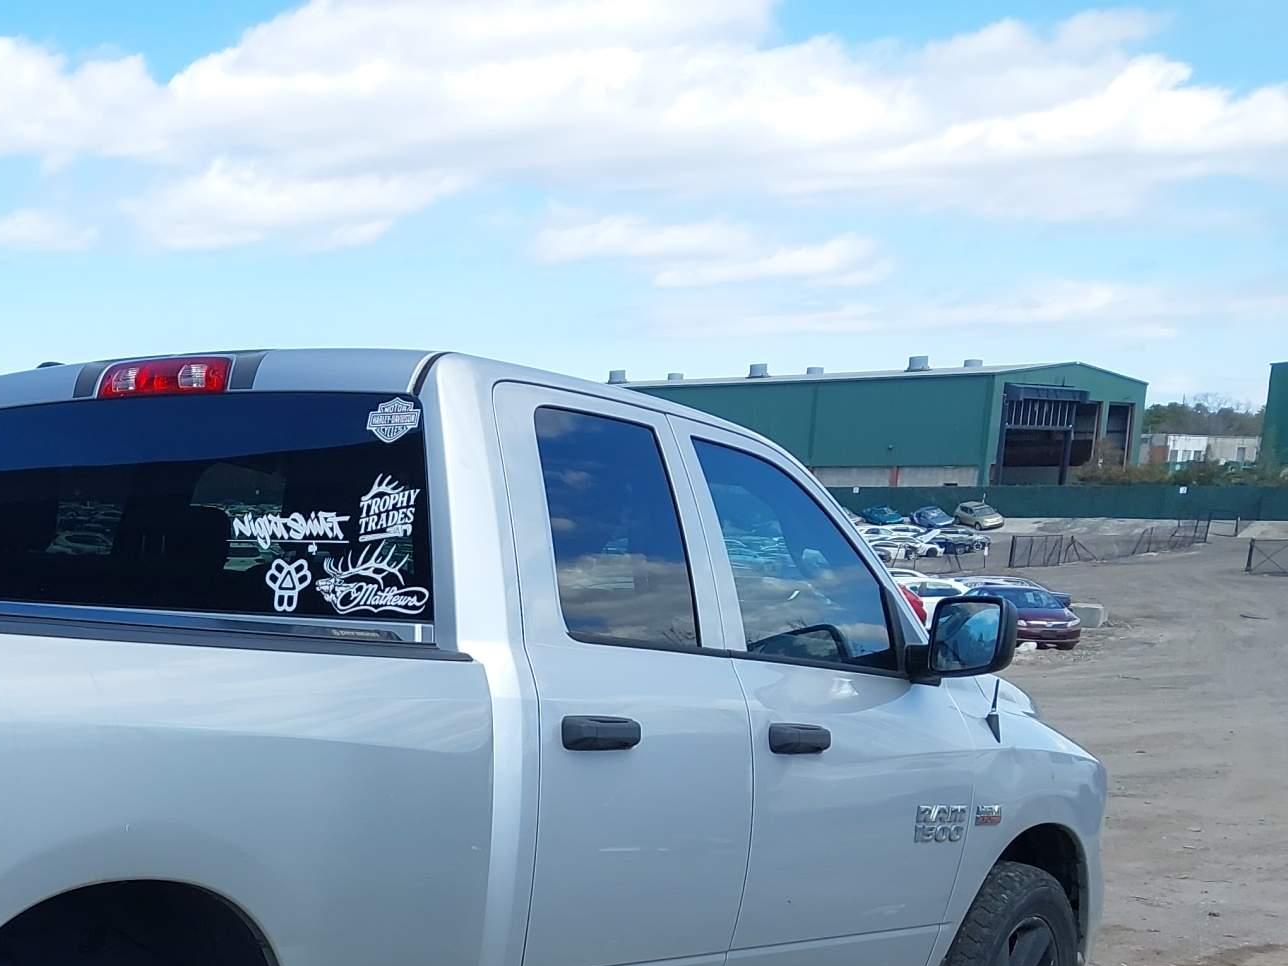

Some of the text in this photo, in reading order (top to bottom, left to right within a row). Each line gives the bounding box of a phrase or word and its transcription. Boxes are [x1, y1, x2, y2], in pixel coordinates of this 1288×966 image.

[360, 489, 420, 518] TROPHY
[359, 507, 416, 534] TRADES
[338, 582, 429, 610] Mathews
